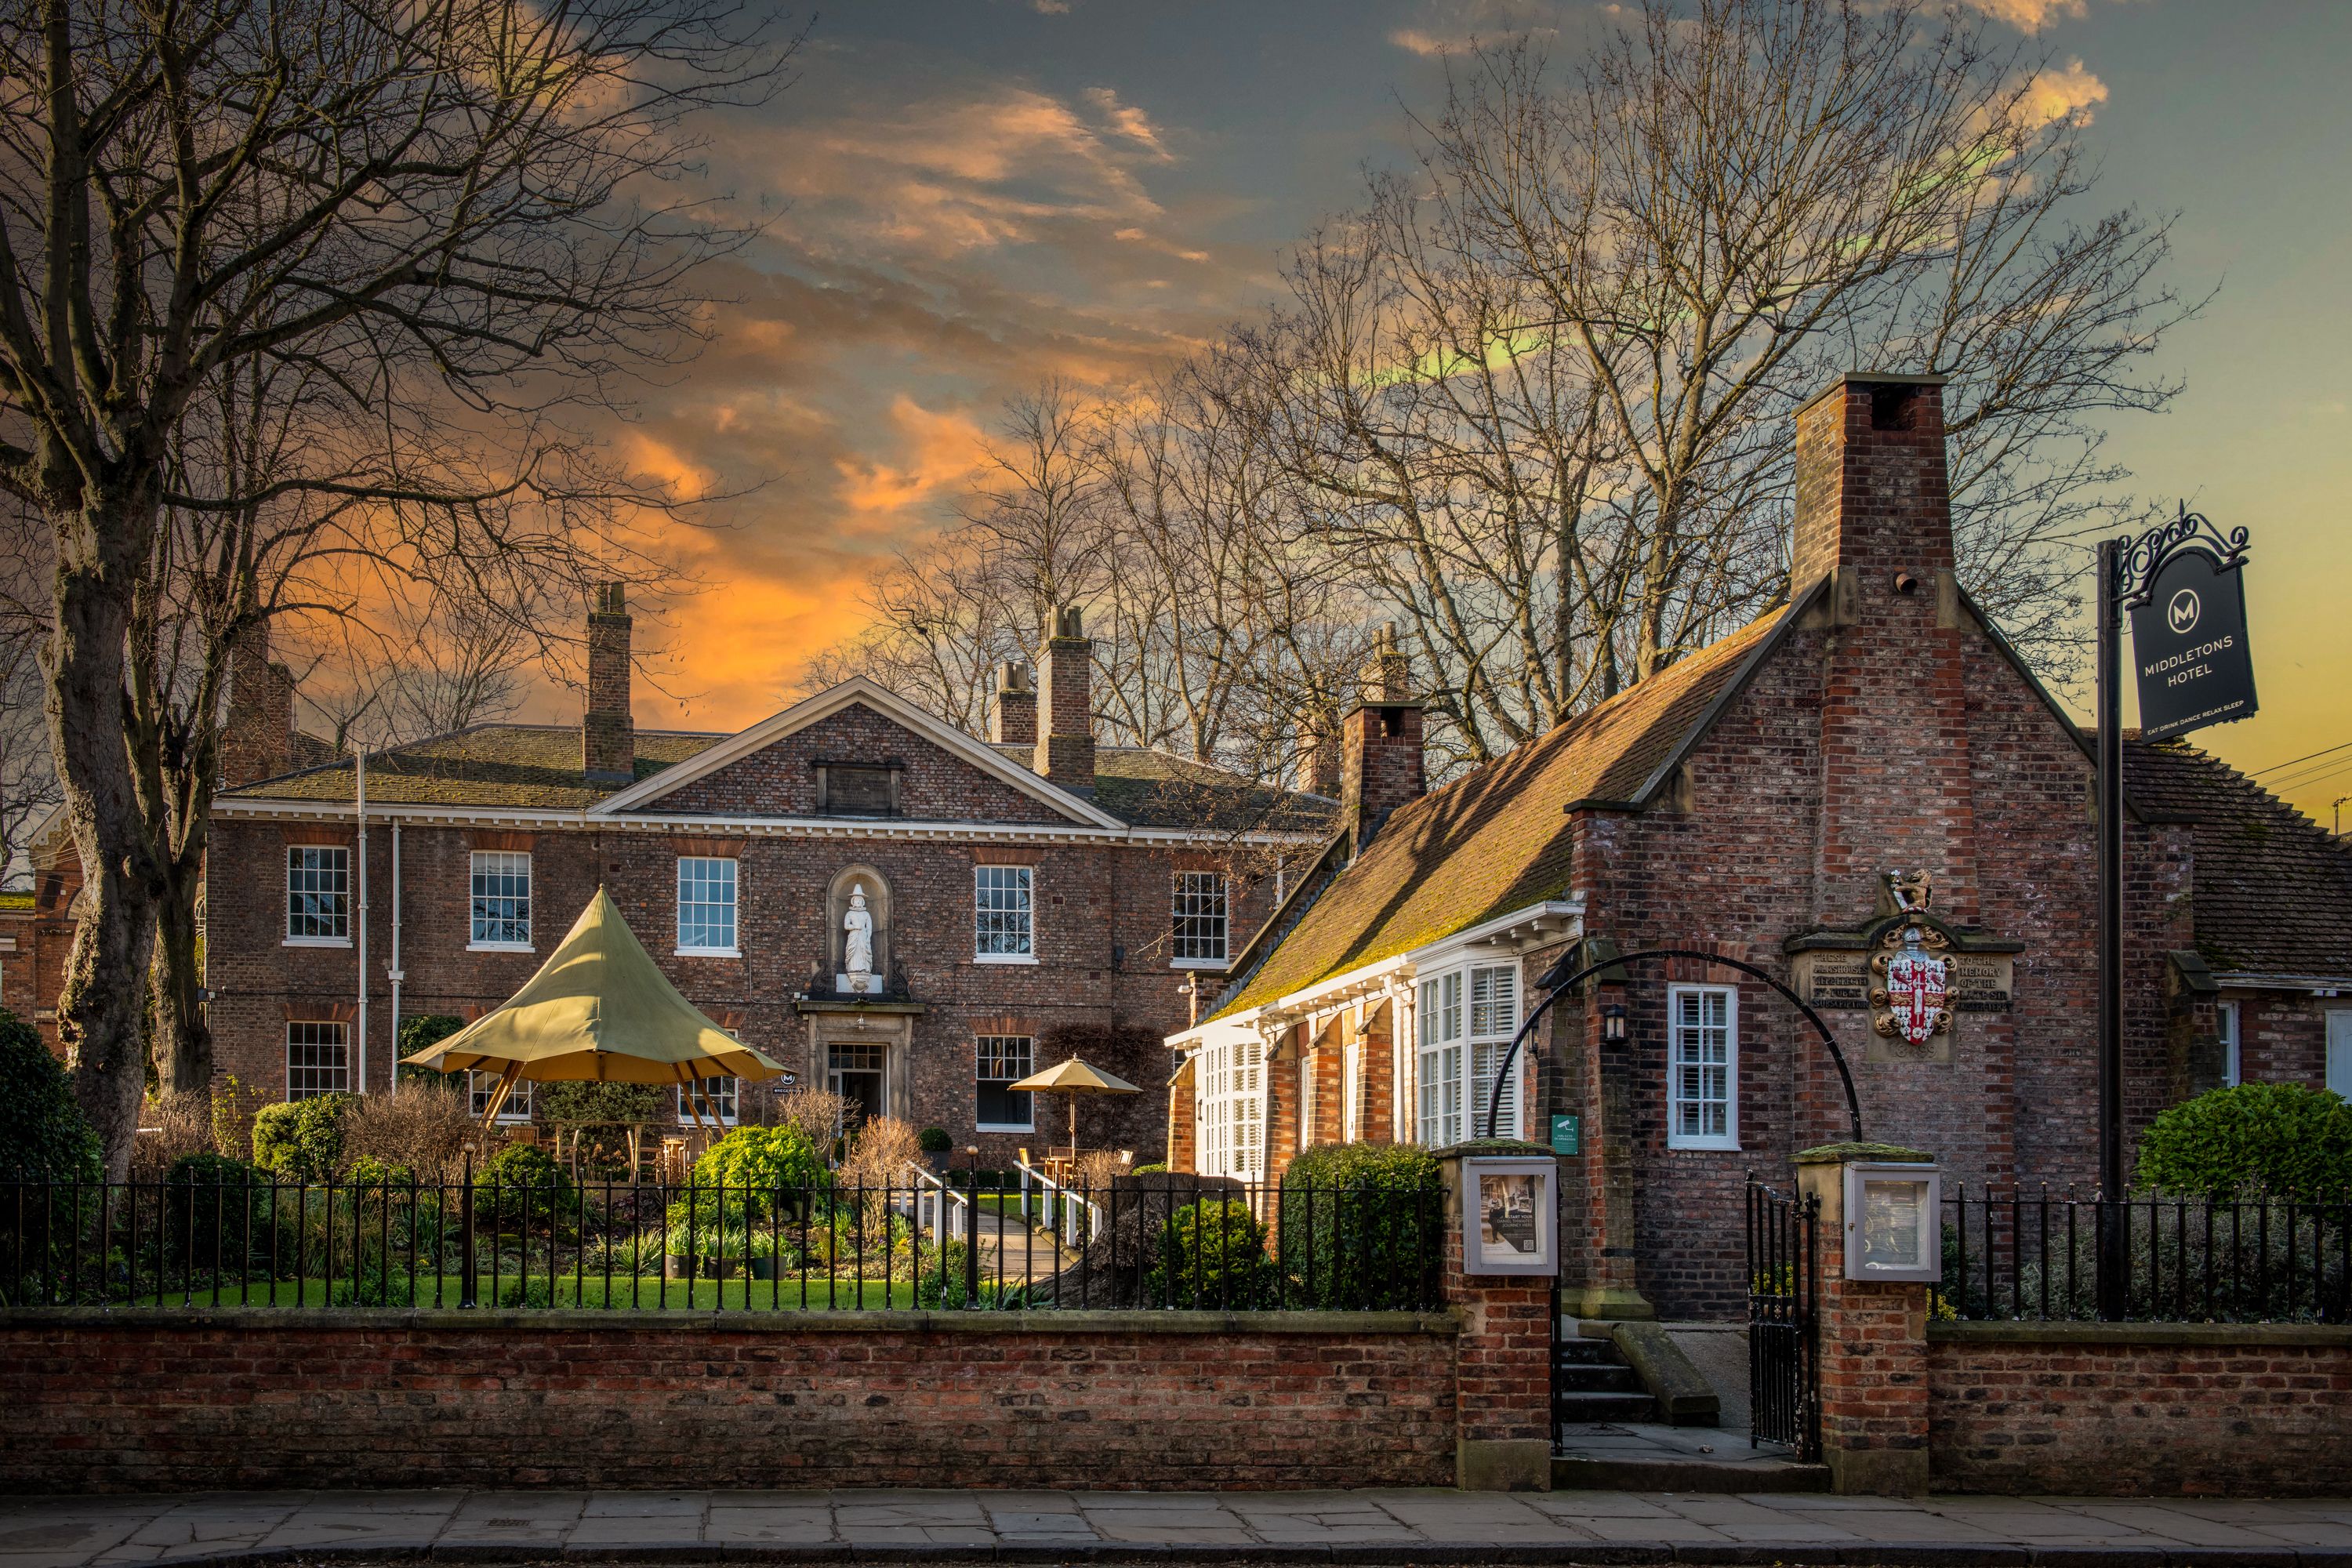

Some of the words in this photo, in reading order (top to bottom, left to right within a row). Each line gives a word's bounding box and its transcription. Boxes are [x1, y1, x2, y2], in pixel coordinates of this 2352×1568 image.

[2173, 597, 2194, 625] M
[2144, 635, 2233, 677] MIDDLETONS
[2168, 663, 2212, 687] HOTEL
[2159, 720, 2179, 731] DRINK
[2180, 713, 2201, 725] DANCE
[2202, 706, 2223, 717] RELAX
[2223, 699, 2245, 711] SLEEP
[1960, 967, 2002, 977] MEMORY
